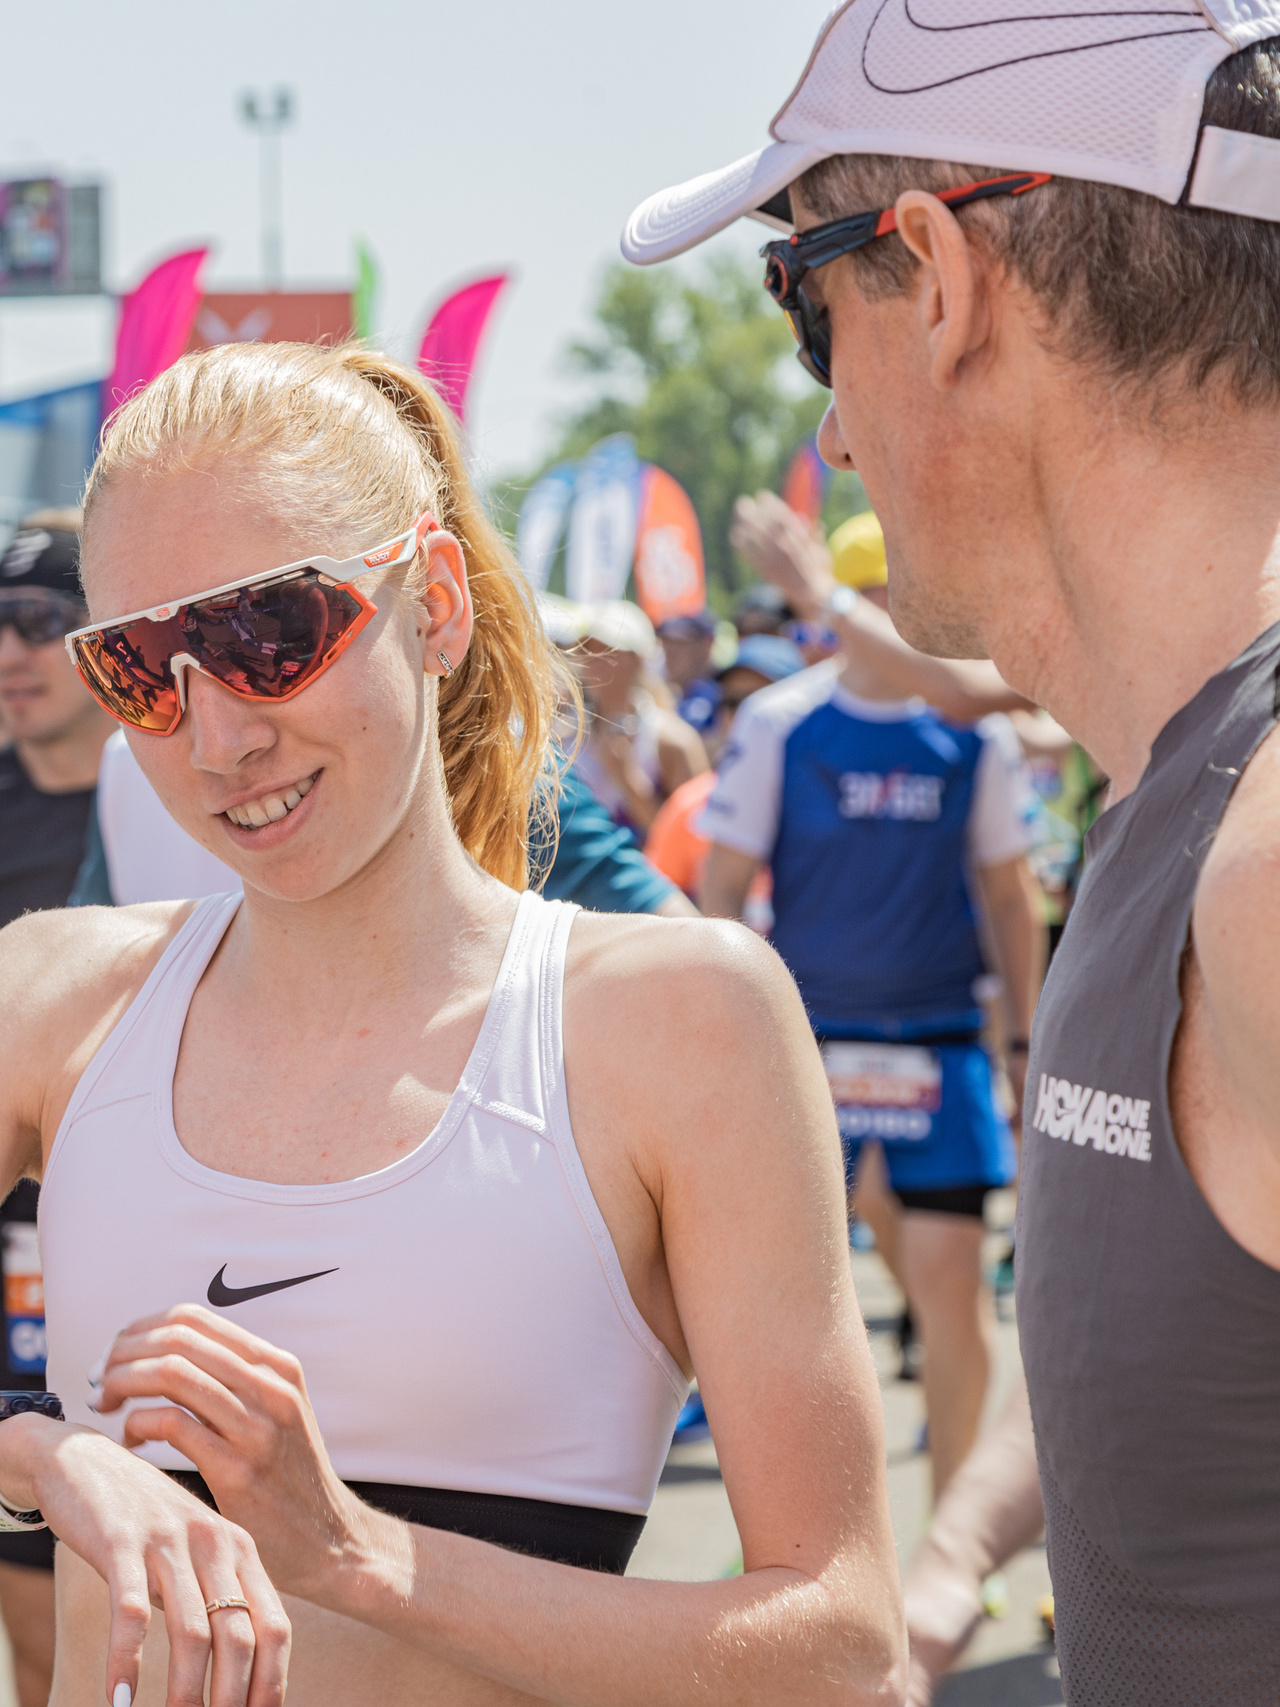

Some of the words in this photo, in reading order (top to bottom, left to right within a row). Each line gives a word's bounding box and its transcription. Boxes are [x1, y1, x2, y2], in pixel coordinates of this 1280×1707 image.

[369, 551, 390, 563] RUDY
[1033, 1073, 1108, 1151] HOKA
[1107, 1093, 1151, 1130] ONE
